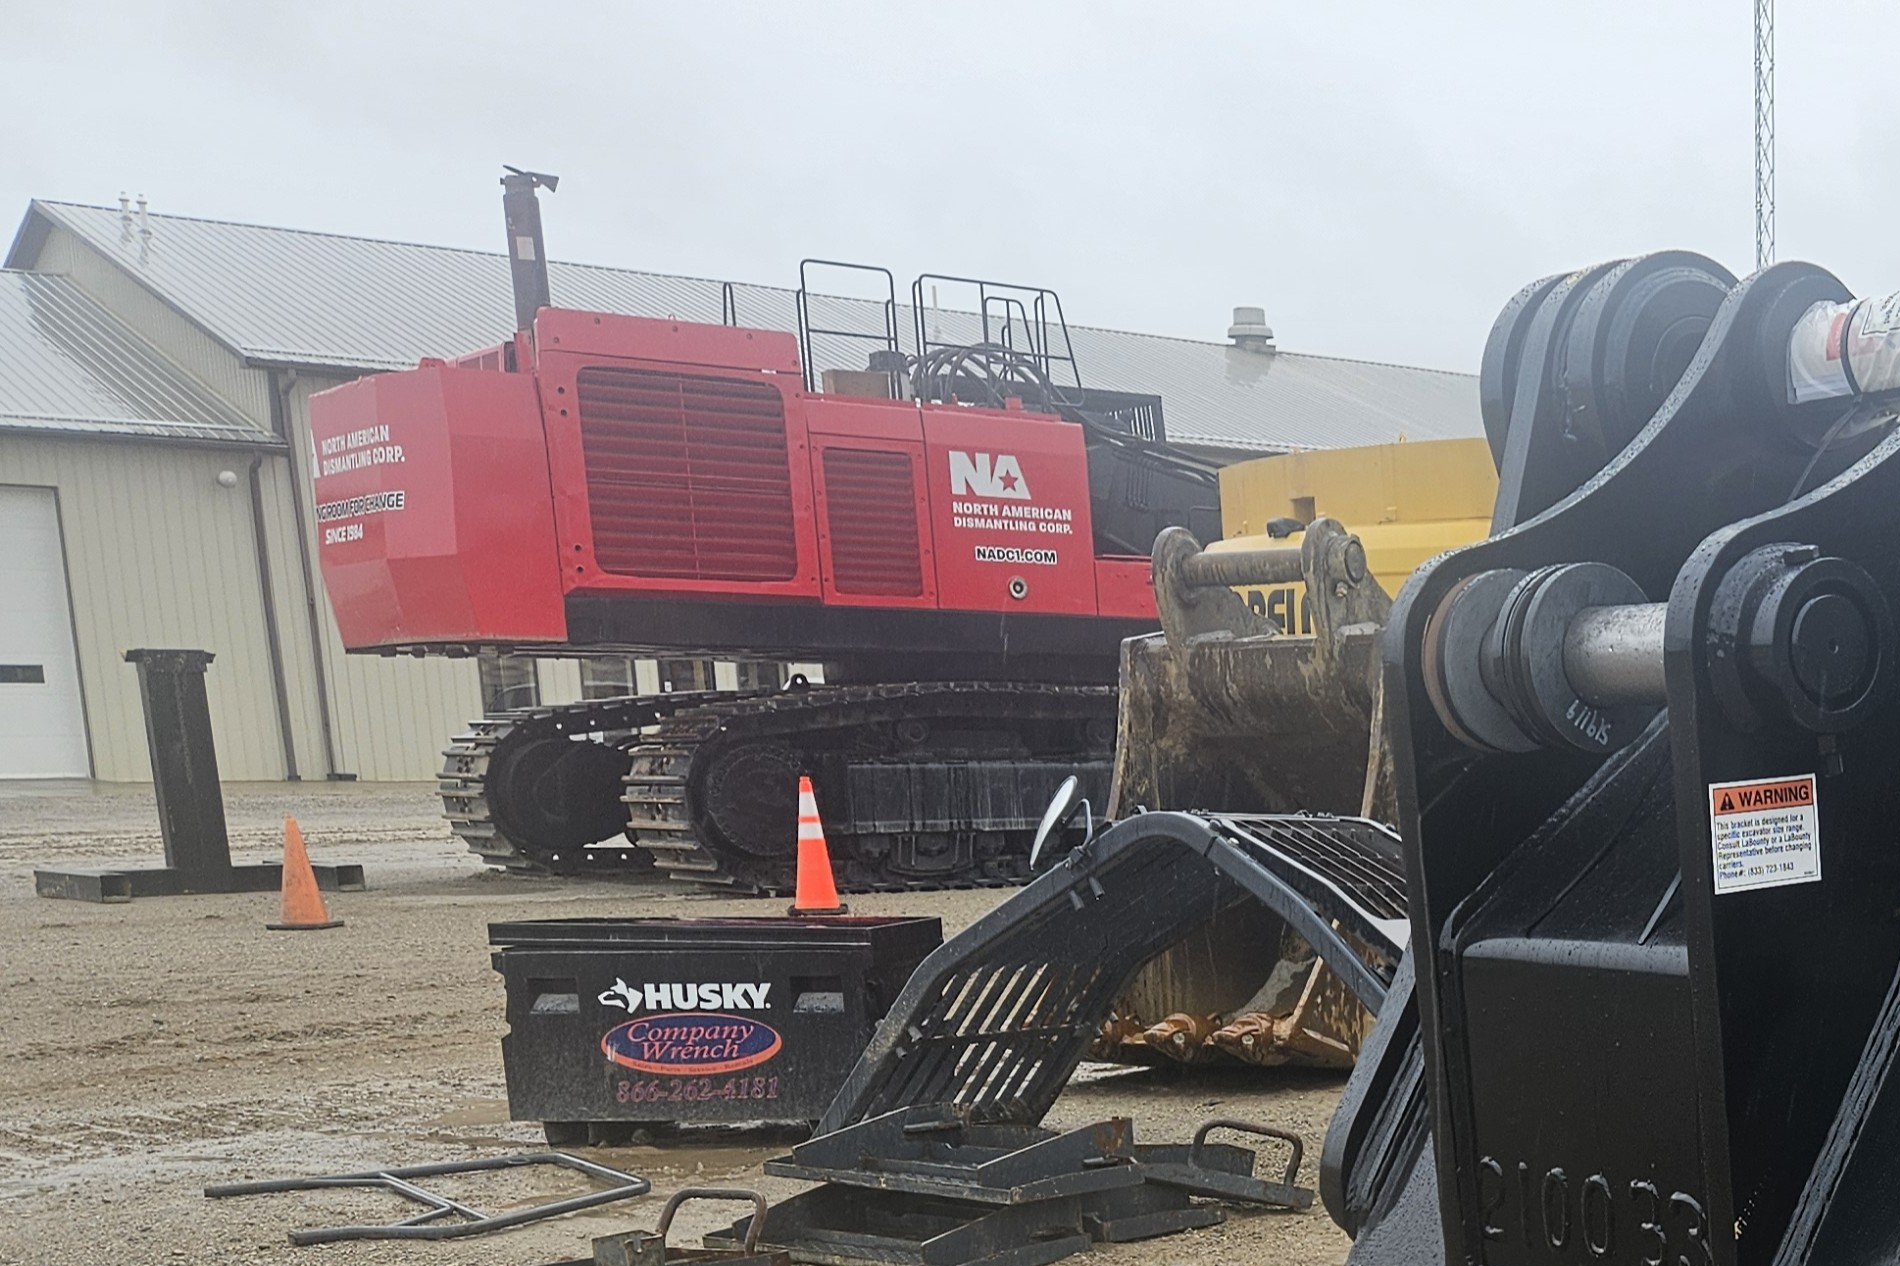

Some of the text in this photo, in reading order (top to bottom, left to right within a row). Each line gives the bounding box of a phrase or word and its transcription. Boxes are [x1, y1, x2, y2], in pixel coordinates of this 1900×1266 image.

[321, 433, 346, 456] NORTH
[346, 424, 390, 450] AMERICAN
[322, 449, 372, 477] DISMANTLING
[372, 445, 406, 466] CORP.
[948, 450, 1032, 500] NA
[349, 495, 366, 518] FOR
[365, 490, 405, 515] CHANGE
[952, 501, 1072, 521] NORTH AMERICAN
[325, 525, 347, 545] SINCE
[953, 516, 1073, 534] DISMANTLING CORP.
[975, 546, 1057, 565] NADC1.COM
[1738, 785, 1809, 807] WARNING
[1717, 822, 1729, 831] This
[1730, 818, 1753, 830] bracket
[1754, 818, 1760, 826] is
[1761, 815, 1788, 827] designed
[1790, 814, 1799, 822] for
[1717, 831, 1740, 841] specific
[1742, 827, 1771, 838] excavator
[1773, 825, 1784, 833] size
[1717, 840, 1741, 851] Consult
[1741, 837, 1770, 848] LaBounty
[1784, 832, 1811, 843] LaBounty
[1718, 841, 1812, 861] Representative before changing
[626, 1022, 754, 1045] Company
[641, 1039, 740, 1060] Wrench
[616, 1076, 779, 1104] 866-262-4181
